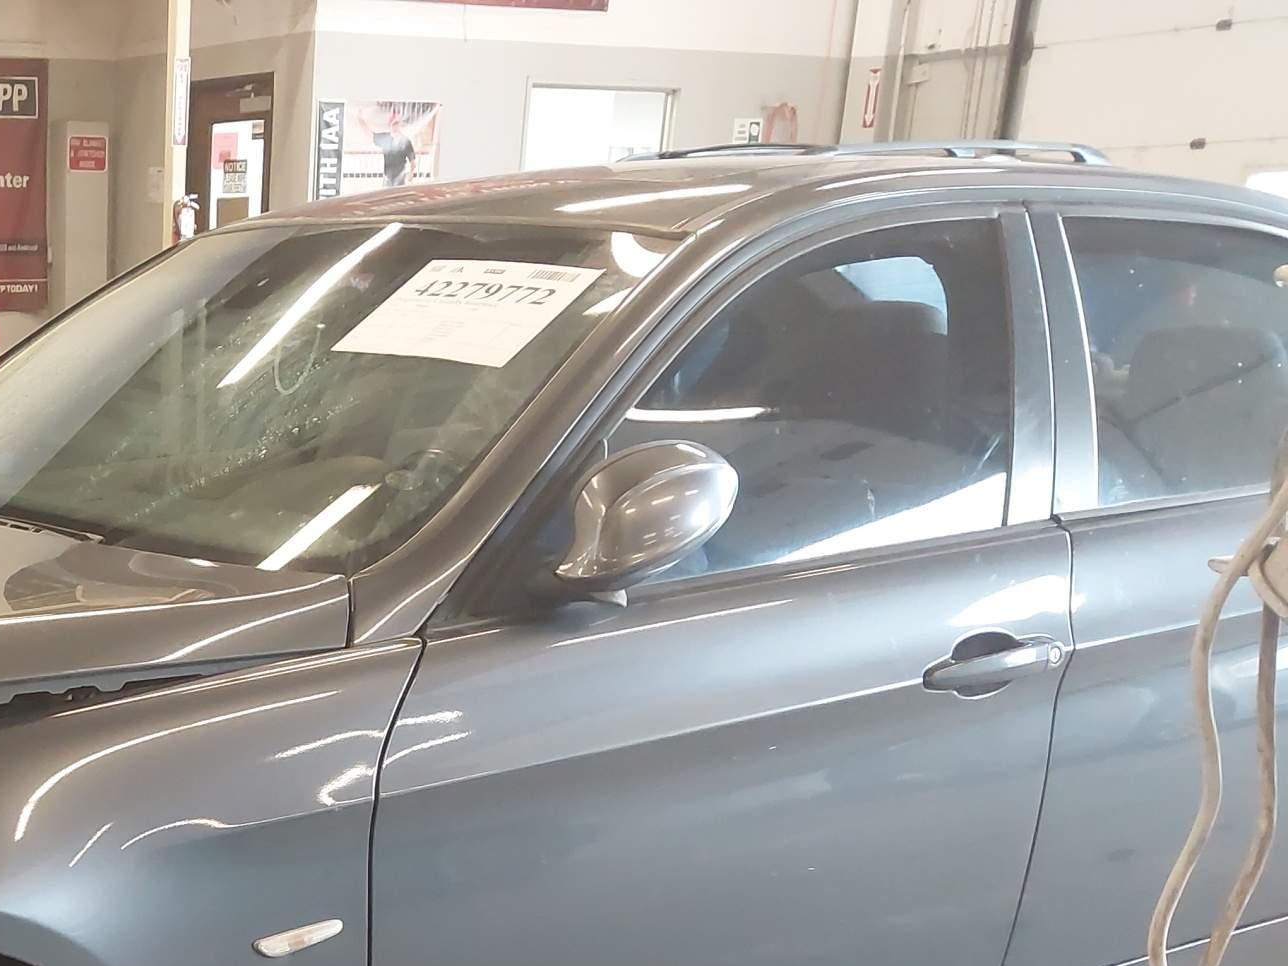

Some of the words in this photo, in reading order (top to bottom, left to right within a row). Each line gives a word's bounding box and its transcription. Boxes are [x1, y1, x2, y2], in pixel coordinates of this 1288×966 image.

[321, 106, 341, 150] IAA
[319, 157, 338, 198] ITH
[415, 280, 556, 305] 42279772
